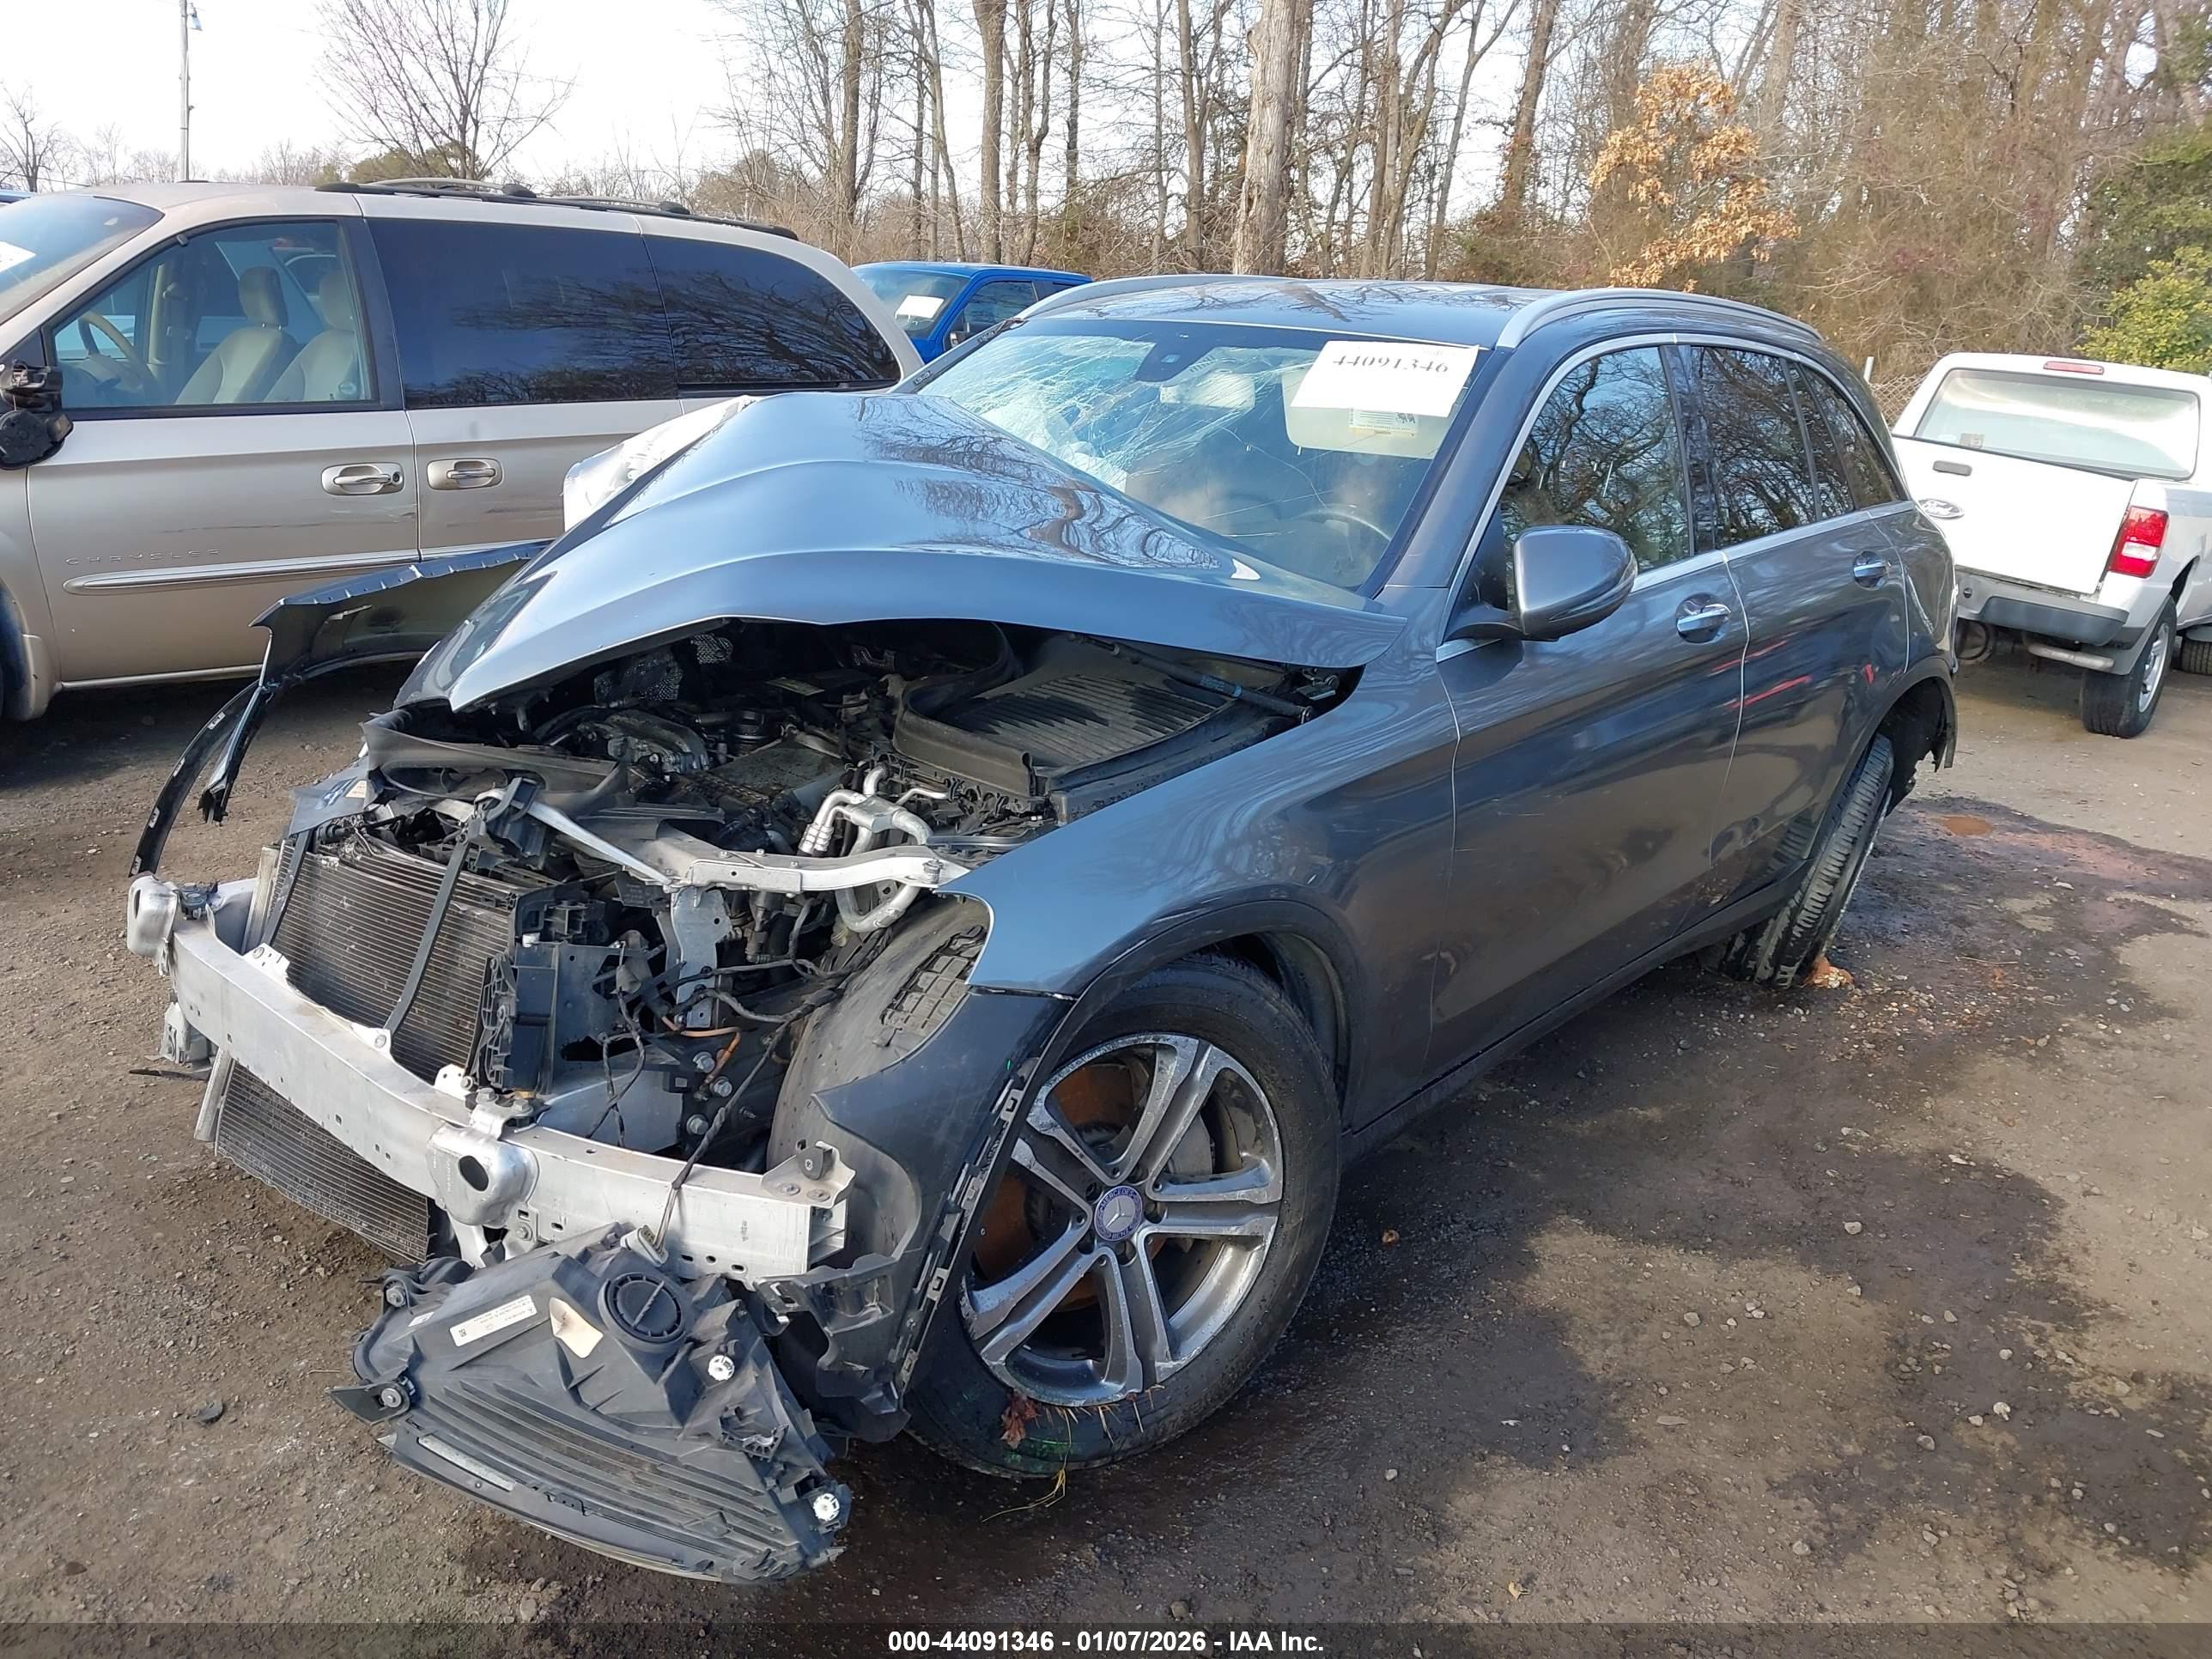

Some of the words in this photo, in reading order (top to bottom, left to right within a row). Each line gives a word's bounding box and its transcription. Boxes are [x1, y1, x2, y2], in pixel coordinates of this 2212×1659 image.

[1332, 355, 1449, 373] 44091346
[65, 549, 221, 565] CHRYSLER
[1100, 1188, 1134, 1208] MERCEDES
[1111, 1226, 1133, 1240] BENZ
